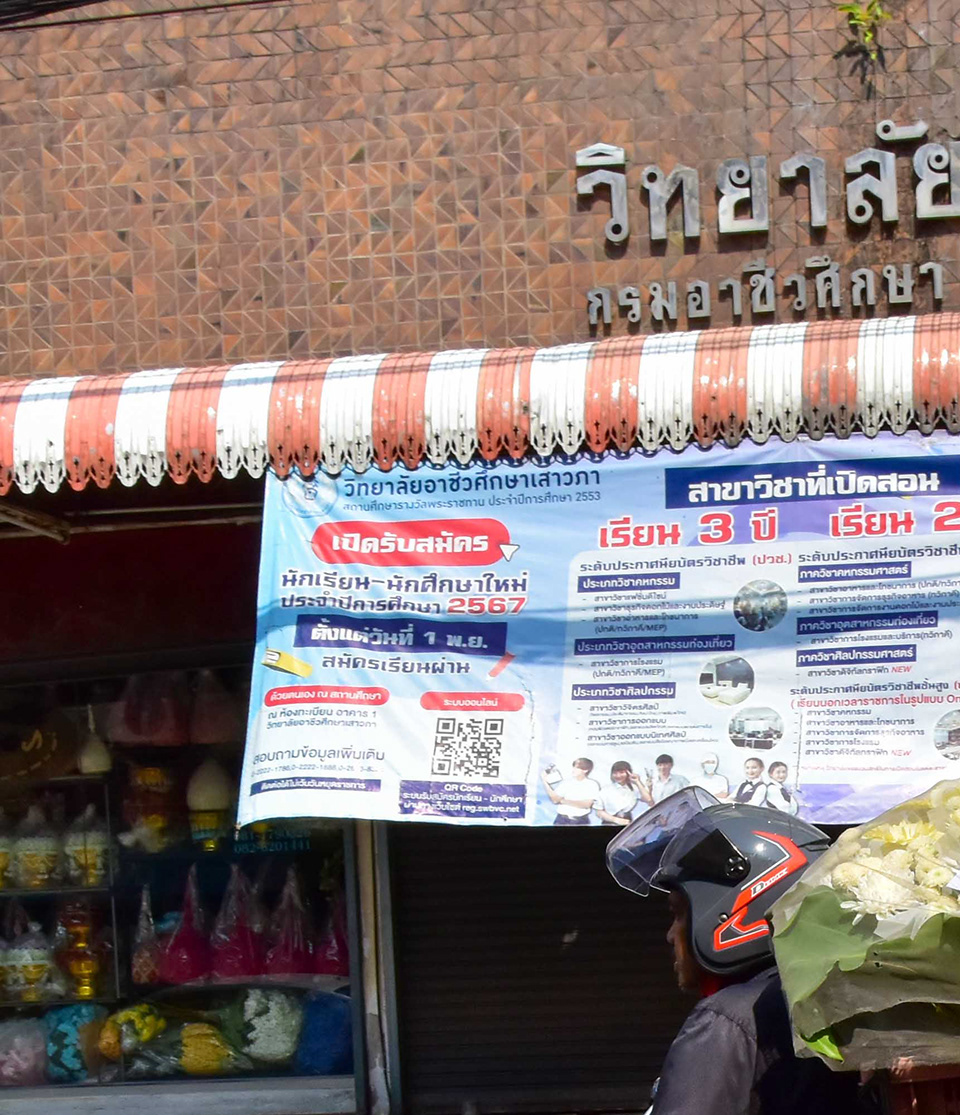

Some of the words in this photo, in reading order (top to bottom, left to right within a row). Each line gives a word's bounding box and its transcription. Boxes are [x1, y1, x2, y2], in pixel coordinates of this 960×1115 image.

[587, 255, 945, 325] กรมอาชีวศึกษา
[344, 469, 600, 498] วิทยาลัยอาชีวศึกษาเสาวภา
[688, 464, 939, 503] สาขาวิชาที่เปิดสอน
[343, 497, 485, 512] สถานศึกษารางวัลพระราชทาน
[488, 492, 572, 507] ประจำปีการศึกษา
[575, 491, 601, 502] 2553
[599, 516, 681, 548] เรียน
[699, 512, 735, 544] 3
[750, 508, 778, 542] ปี
[830, 505, 914, 538] เรียน
[332, 531, 489, 554] เปิดรับสมัคร
[580, 554, 746, 572] ระดับประกาศนียบัตรวิชาชีพ
[752, 553, 792, 566] (ปวช.)
[281, 569, 528, 594] นักเรียน-นักศึกษาใหม่
[582, 576, 675, 589] ประเภทวิชาคหกรรม
[280, 592, 440, 615] ประจำปีการศึกษา
[447, 597, 528, 615] 2567
[310, 618, 413, 645] ตั้งแต่วันที่
[423, 632, 435, 646] 1
[446, 634, 488, 649] พ.ย.
[322, 655, 471, 675] สมัครเรียนผ่าน
[891, 665, 912, 674] NEW
[573, 684, 674, 699] ประเภทวิชาศิลปกรรม
[253, 744, 385, 765] สอบถามข้อมูลเพิ่มเติม
[444, 784, 459, 792] QR
[460, 784, 483, 792] Code
